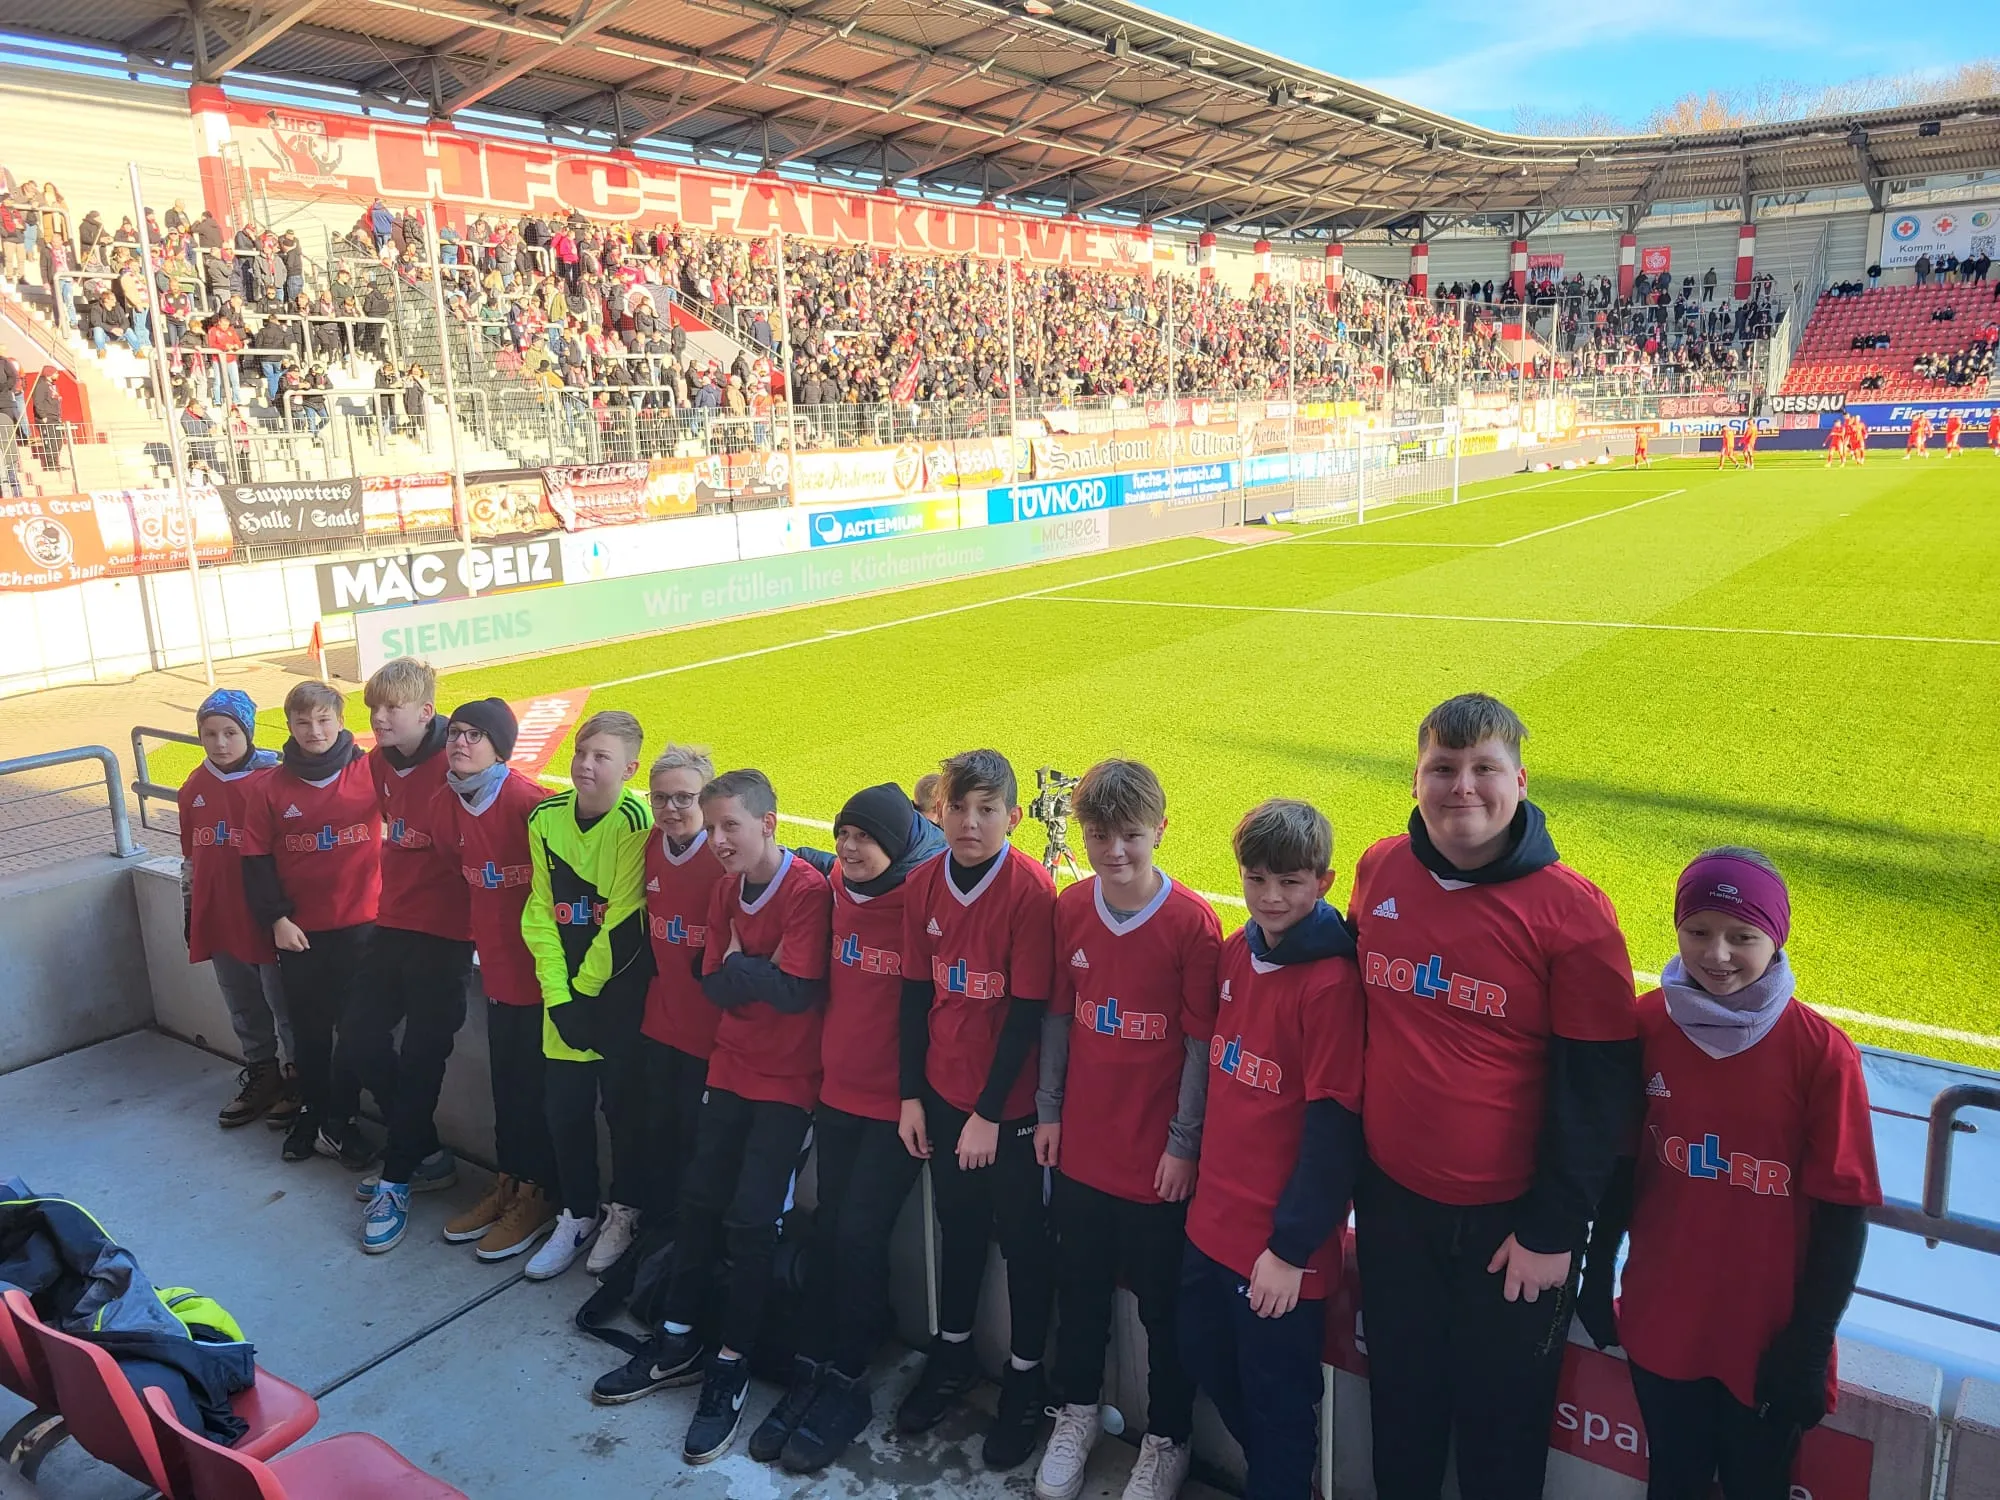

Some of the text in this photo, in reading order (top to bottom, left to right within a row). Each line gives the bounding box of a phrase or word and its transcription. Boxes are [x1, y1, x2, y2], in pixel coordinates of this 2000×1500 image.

[1889, 253, 1921, 264] unser
[1899, 242, 1946, 253] Komm in
[1772, 394, 1845, 413] DESSAU
[1048, 438, 1152, 472] Saalefront
[235, 482, 353, 508] Supporters
[238, 509, 293, 534] Halle
[310, 508, 361, 529] Saale
[843, 515, 924, 539] ACTEMIUM
[331, 541, 553, 608] MÄC GEIZ
[642, 545, 985, 618] Wir erfüllen Ihre Küchenträume
[382, 609, 534, 659] SIEMENS
[285, 824, 370, 852] ROLLER
[1372, 908, 1399, 920] adidas
[1365, 951, 1508, 1018] ROLLER
[1209, 1034, 1283, 1095] OLLER
